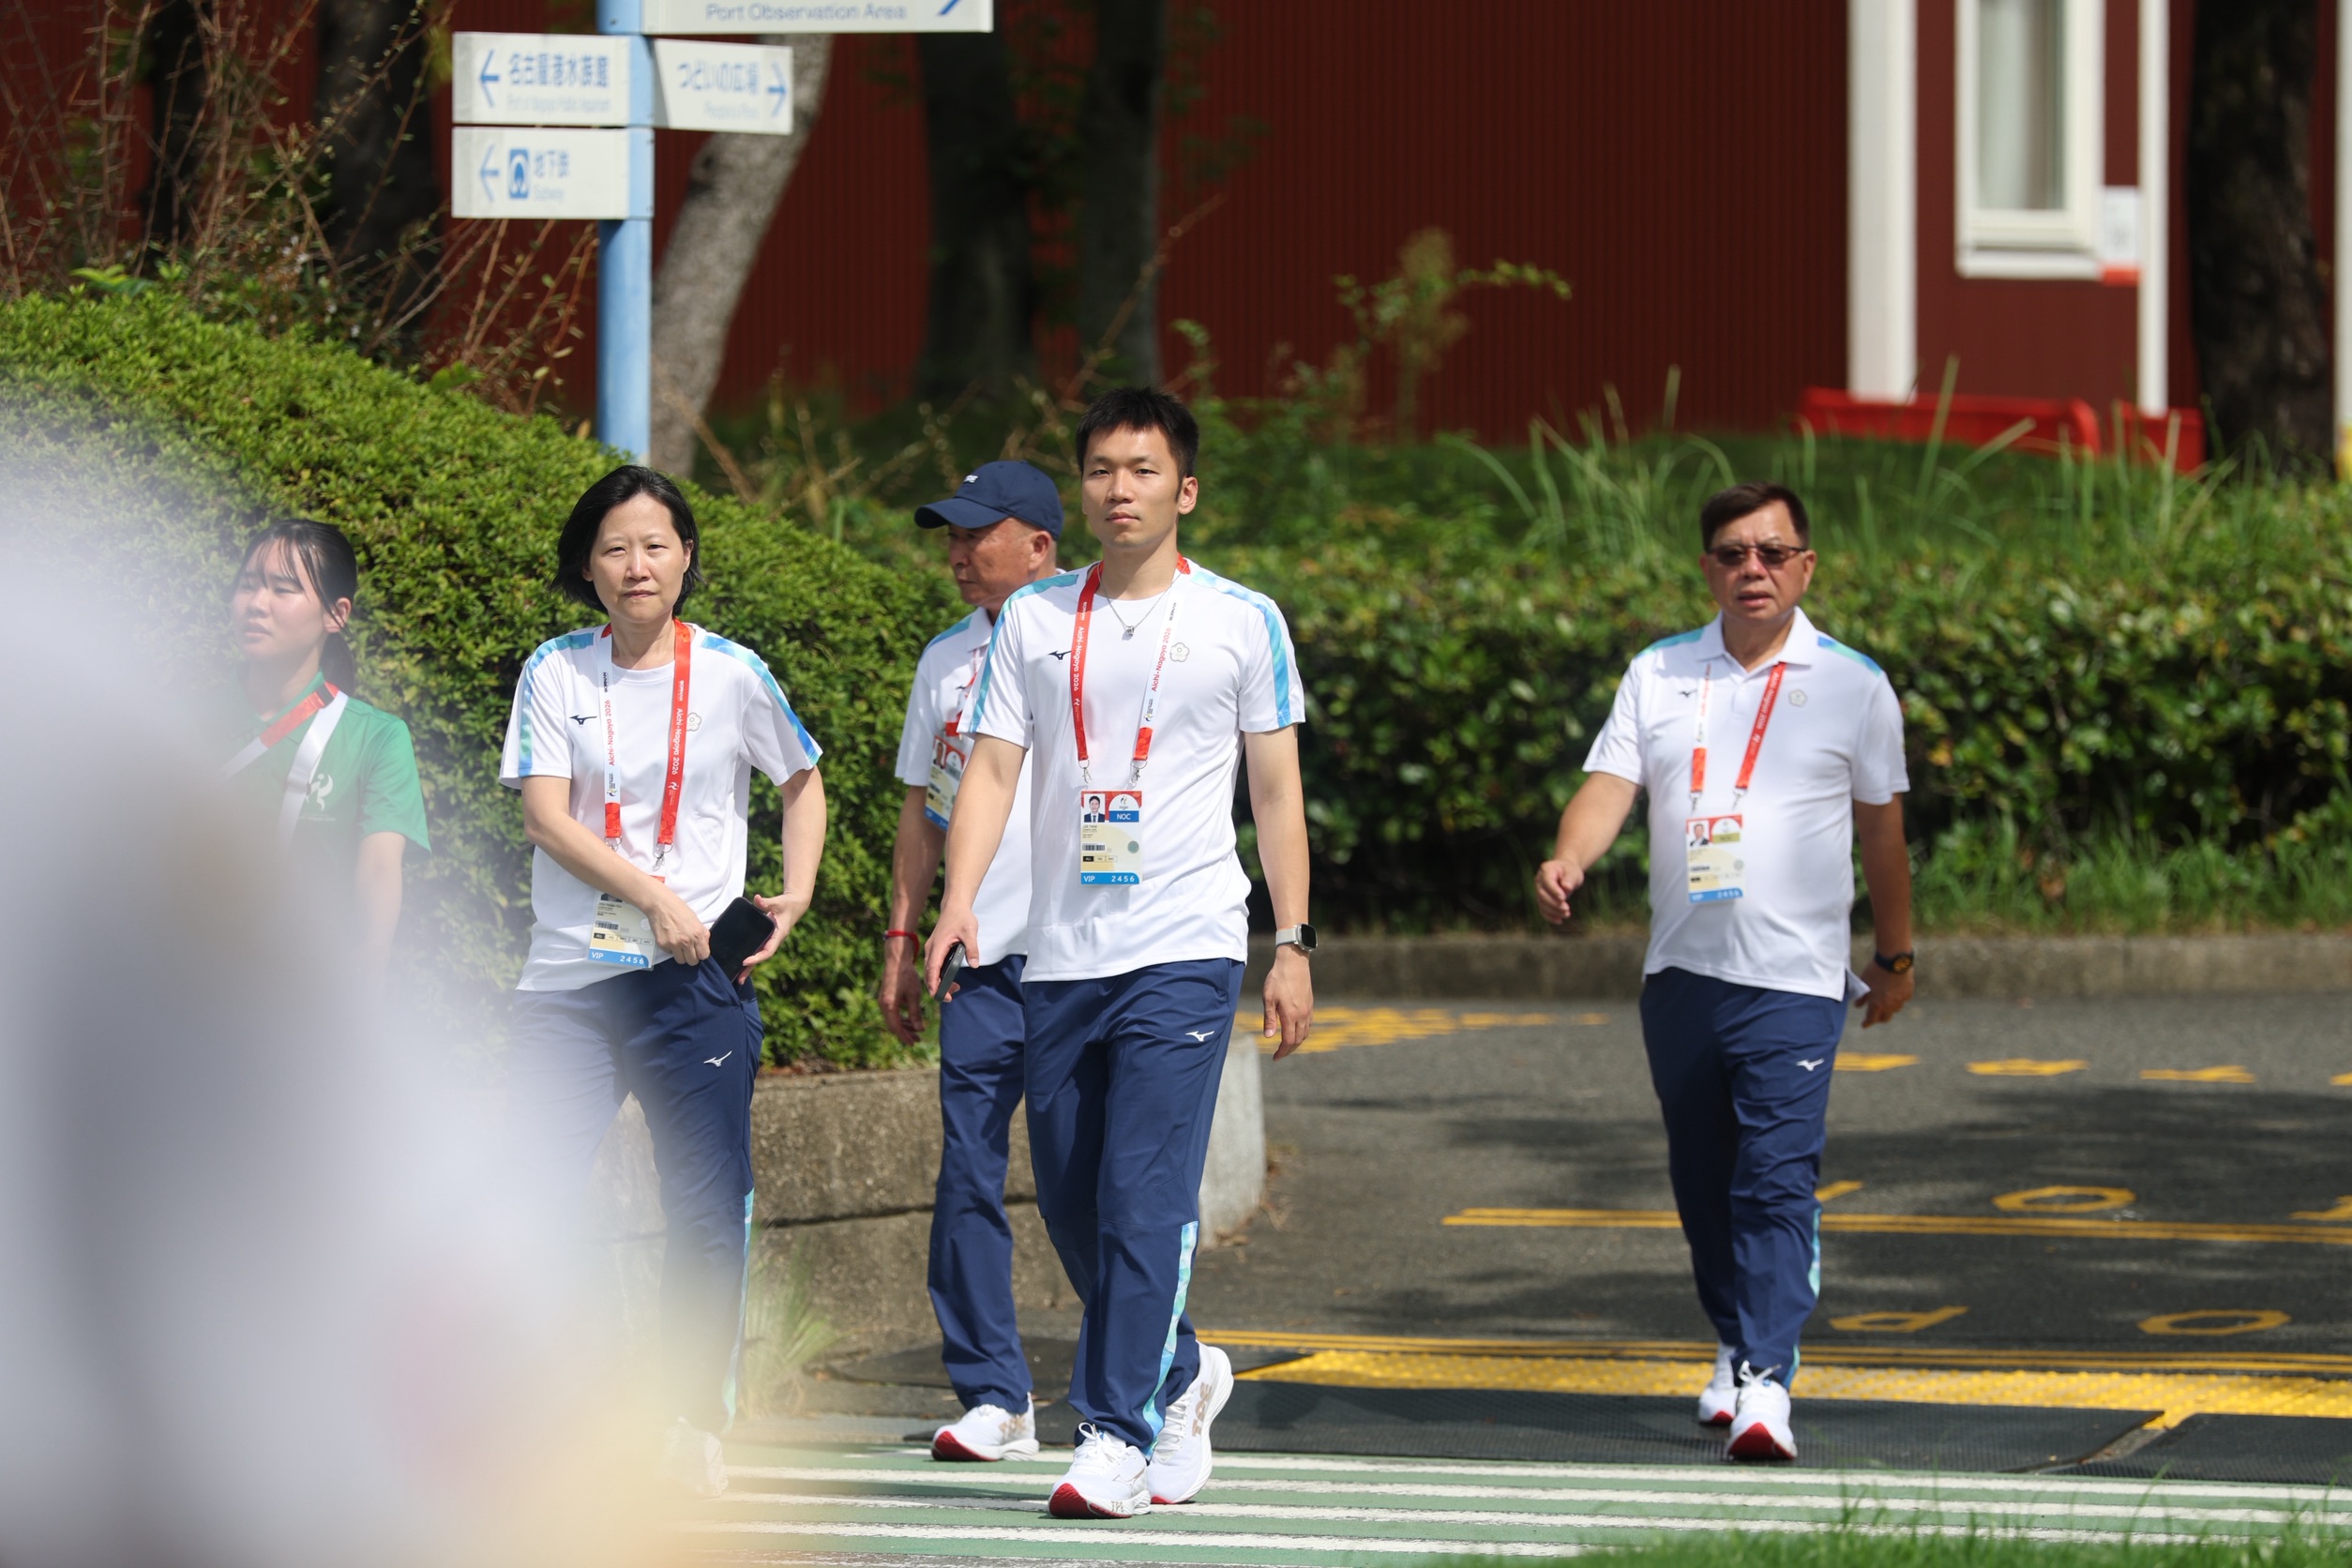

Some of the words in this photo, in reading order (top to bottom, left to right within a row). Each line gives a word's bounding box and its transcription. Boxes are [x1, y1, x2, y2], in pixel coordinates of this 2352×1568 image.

[705, 4, 745, 21] Port
[749, 3, 857, 21] Observation
[863, 3, 907, 20] Area
[1072, 626, 1085, 672] Aichi-Nagoya
[1152, 644, 1168, 691] Aichi-Nagoya
[1163, 627, 1171, 643] 2026
[607, 718, 615, 766] Aichi-Nagoya
[672, 708, 683, 755] Aichi-Nagoya
[671, 756, 680, 776] 2026
[591, 951, 604, 959] VIP
